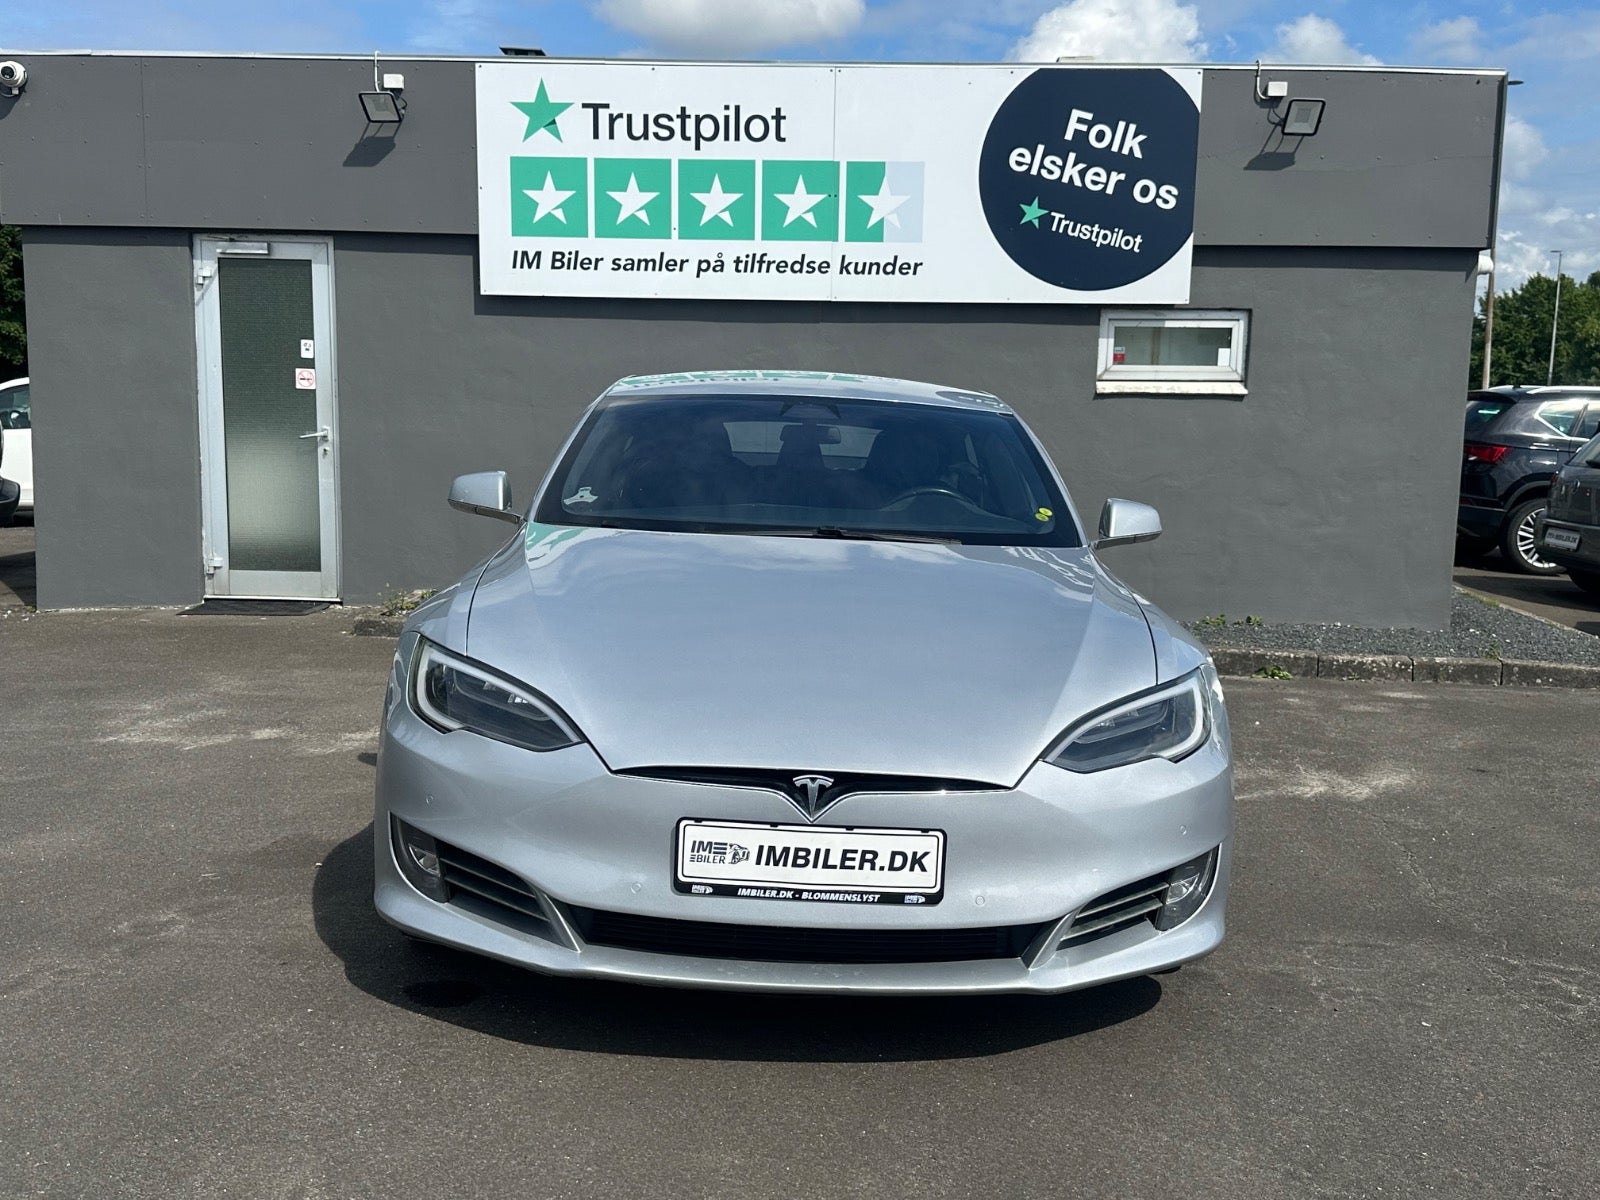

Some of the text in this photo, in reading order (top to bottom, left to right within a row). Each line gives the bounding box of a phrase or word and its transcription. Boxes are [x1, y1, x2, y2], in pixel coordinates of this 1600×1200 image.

[581, 102, 787, 151] Trustpilot
[1063, 108, 1148, 159] Folk
[1008, 143, 1179, 210] elsker os
[1050, 211, 1143, 253] Trustpilot
[512, 250, 924, 279] IM Biler samler på tilfredse kunder
[696, 854, 726, 865] BILER
[755, 844, 931, 873] IMBILER.DK
[737, 887, 795, 899] IMBILER.DK
[801, 891, 880, 903] BLOMMENSLYST
